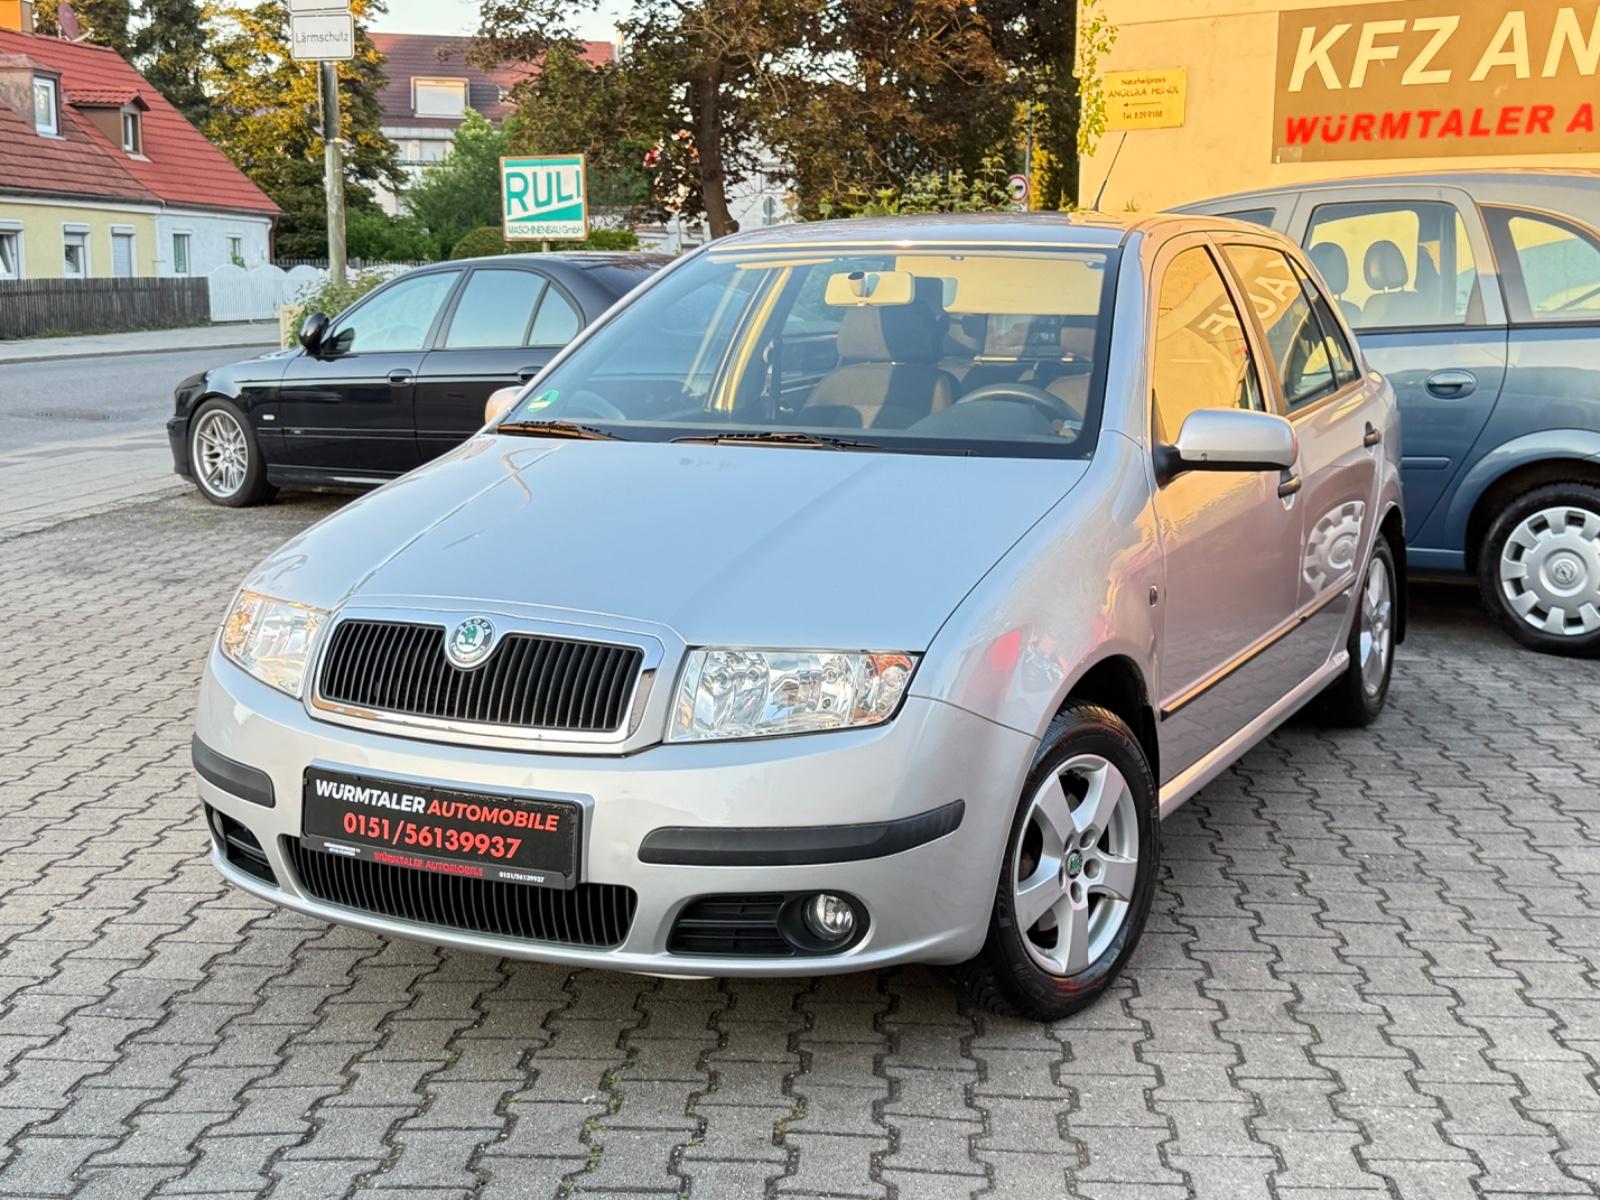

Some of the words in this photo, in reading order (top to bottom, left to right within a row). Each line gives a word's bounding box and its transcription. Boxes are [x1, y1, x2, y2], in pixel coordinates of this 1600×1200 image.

[295, 31, 349, 43] Lärmschutz
[1288, 15, 1459, 92] KFZ
[1286, 103, 1555, 144] WÜRMTALER
[505, 170, 581, 216] RULI
[315, 779, 426, 815] WÜRMTALER
[427, 799, 560, 832] AUTOMOBILE
[343, 812, 522, 859] 0151/56139937
